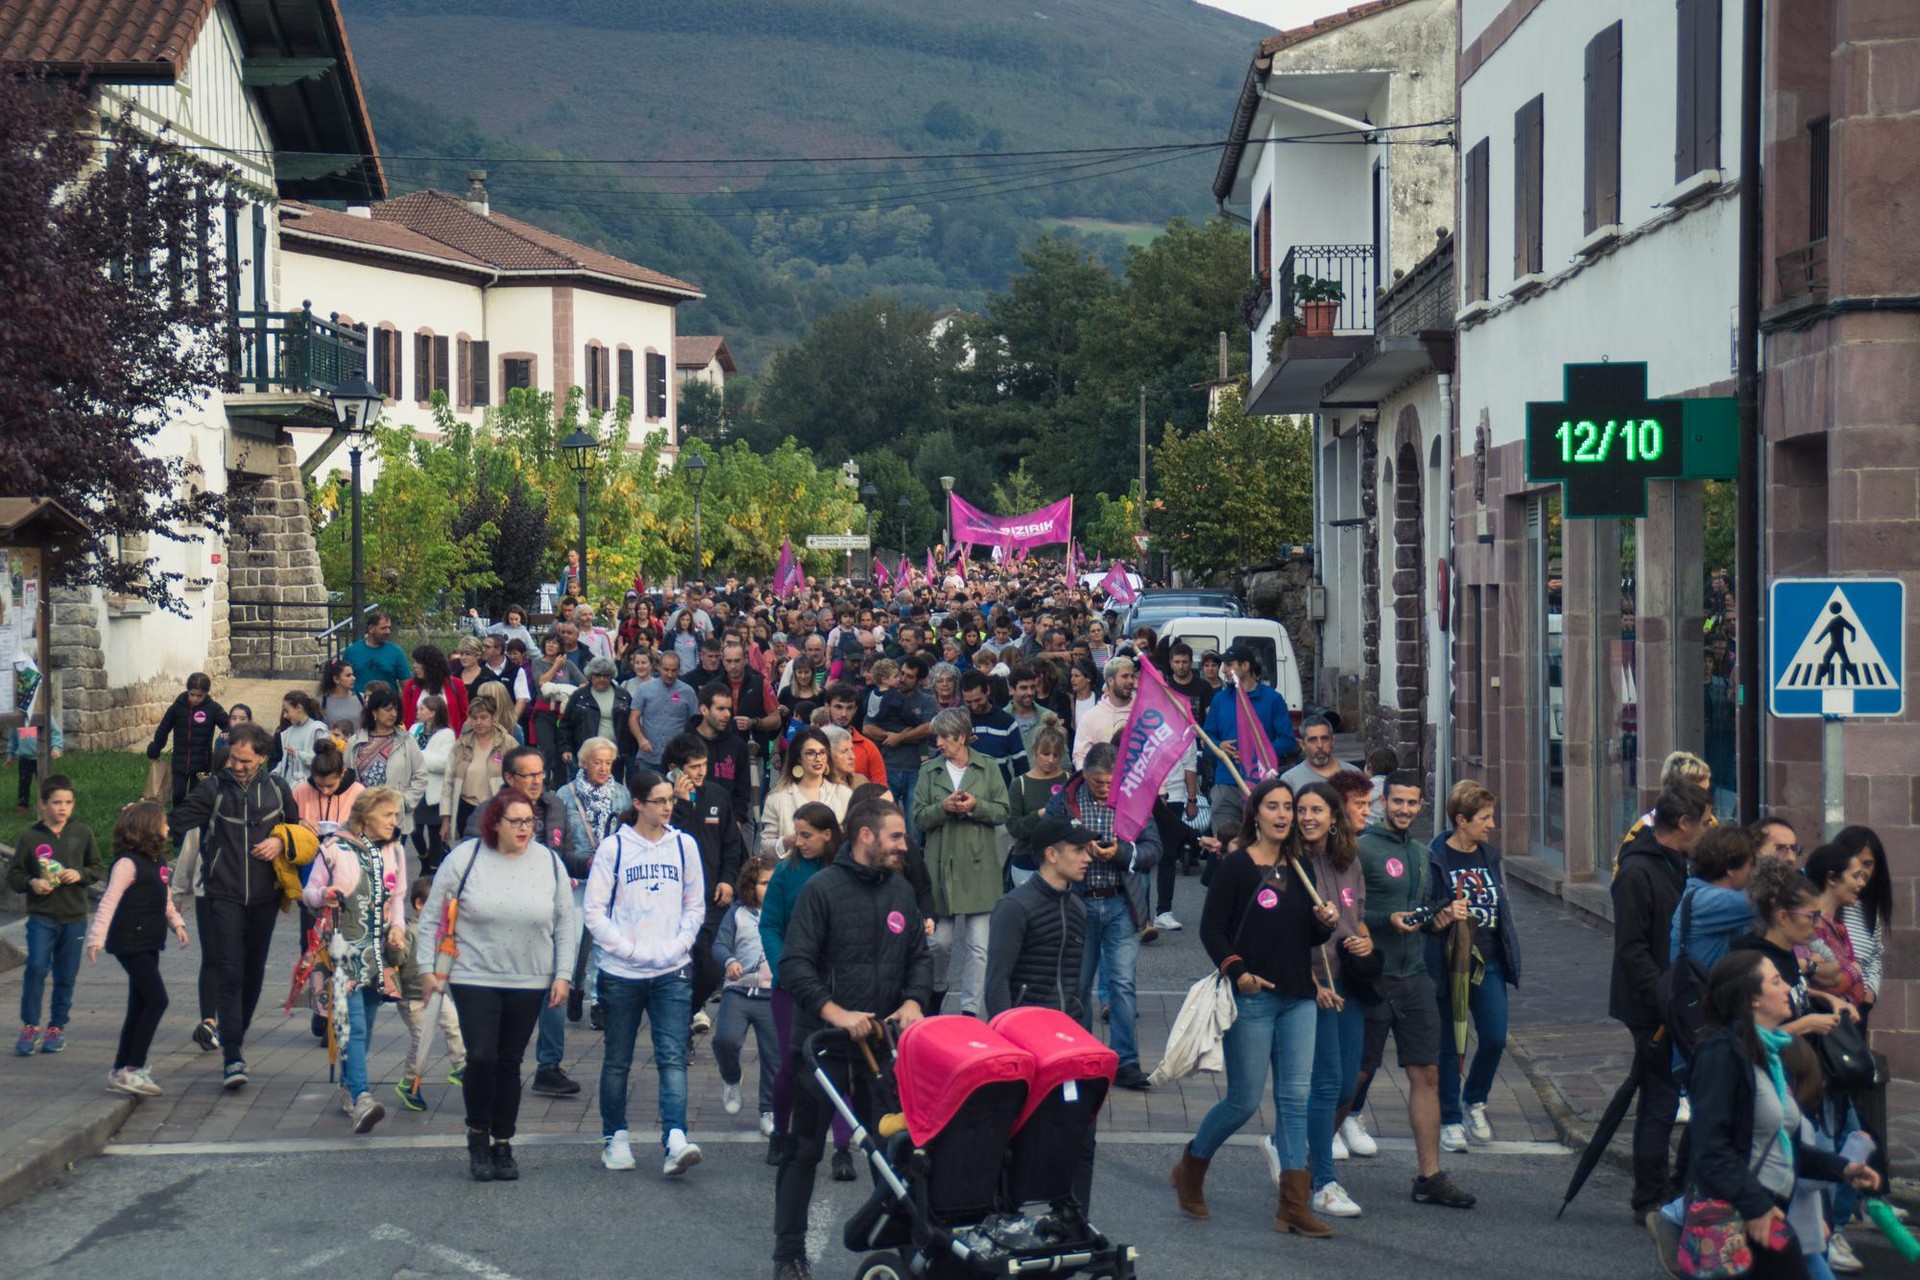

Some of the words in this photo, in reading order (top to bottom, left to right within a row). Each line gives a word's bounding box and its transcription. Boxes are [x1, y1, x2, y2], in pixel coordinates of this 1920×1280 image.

[1555, 419, 1663, 462] 12/10
[373, 858, 382, 905] BEAUTIFUL
[625, 863, 680, 885] HOLLISTER
[373, 938, 384, 984] BEAUTIFUL
